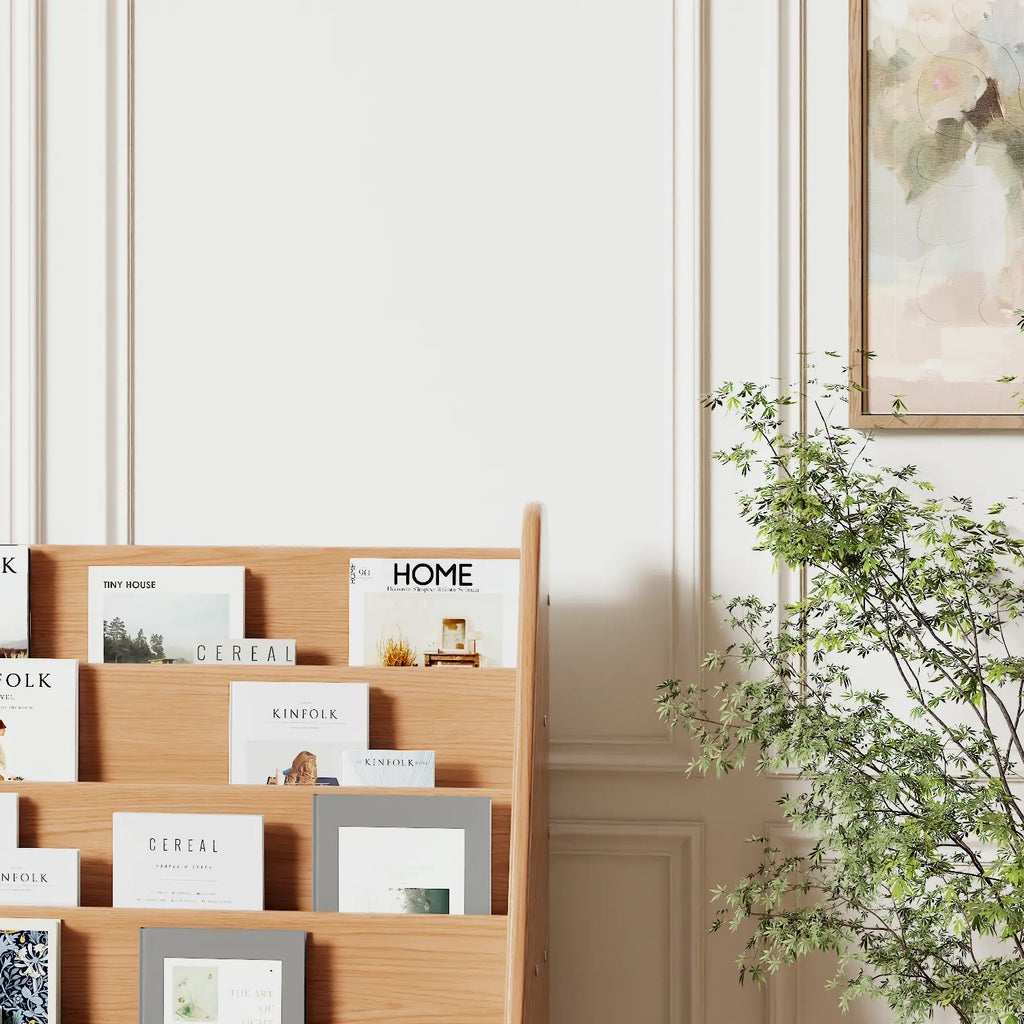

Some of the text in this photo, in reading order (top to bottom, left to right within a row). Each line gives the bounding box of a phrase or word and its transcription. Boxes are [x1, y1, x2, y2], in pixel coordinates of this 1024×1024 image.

[394, 563, 472, 586] HOME
[103, 581, 156, 589] TINY HOUSE
[196, 644, 293, 662] CEREAL
[273, 708, 338, 720] KINFOLK
[364, 758, 414, 767] KINFOLK
[149, 837, 218, 853] CEREAL
